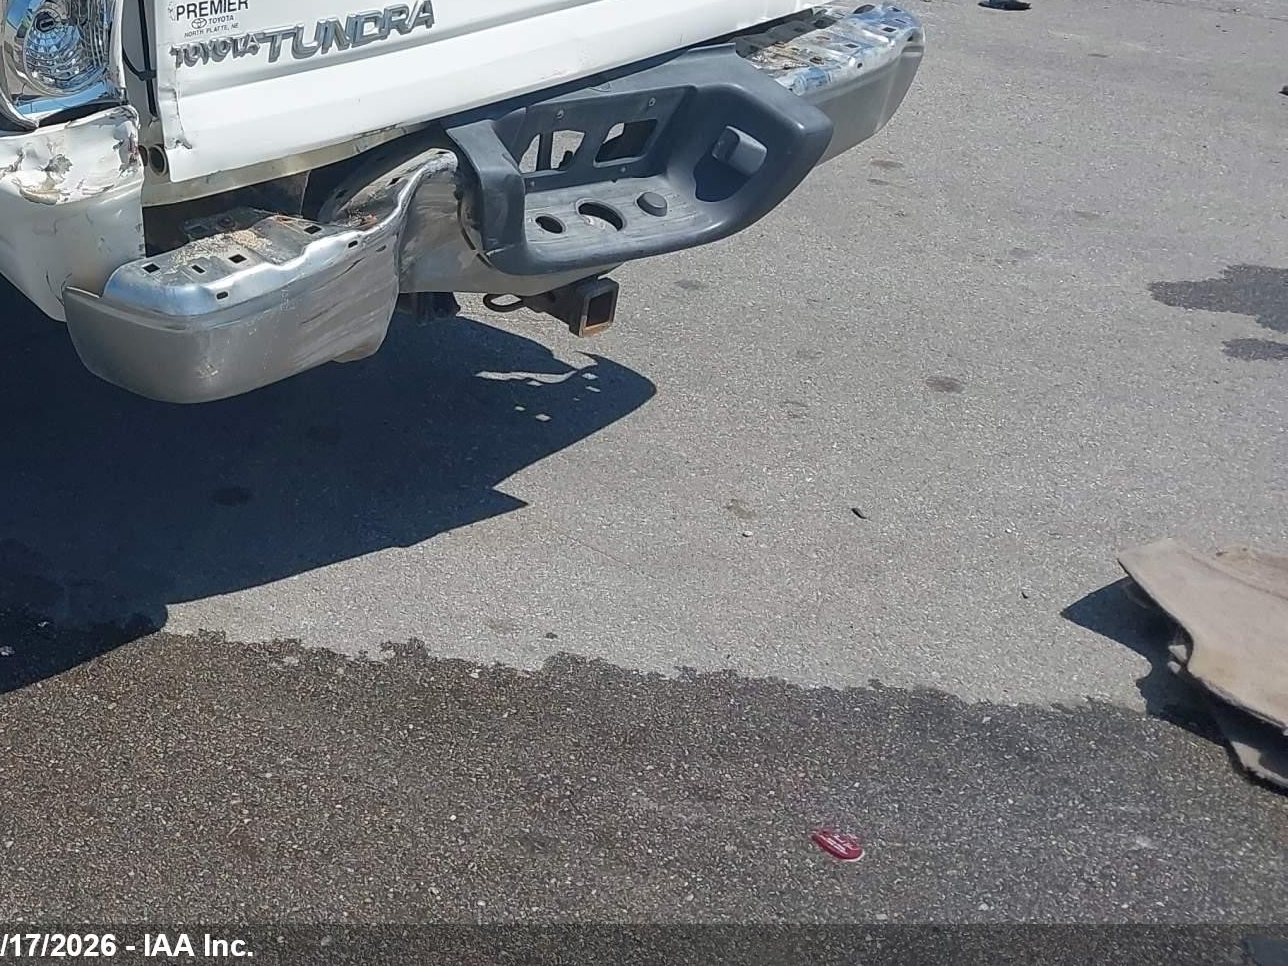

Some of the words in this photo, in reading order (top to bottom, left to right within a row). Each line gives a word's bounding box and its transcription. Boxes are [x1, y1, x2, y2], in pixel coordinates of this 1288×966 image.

[208, 14, 234, 25] TOYOTA
[183, 29, 204, 38] NORTH
[169, 33, 260, 68] TOYOTA
